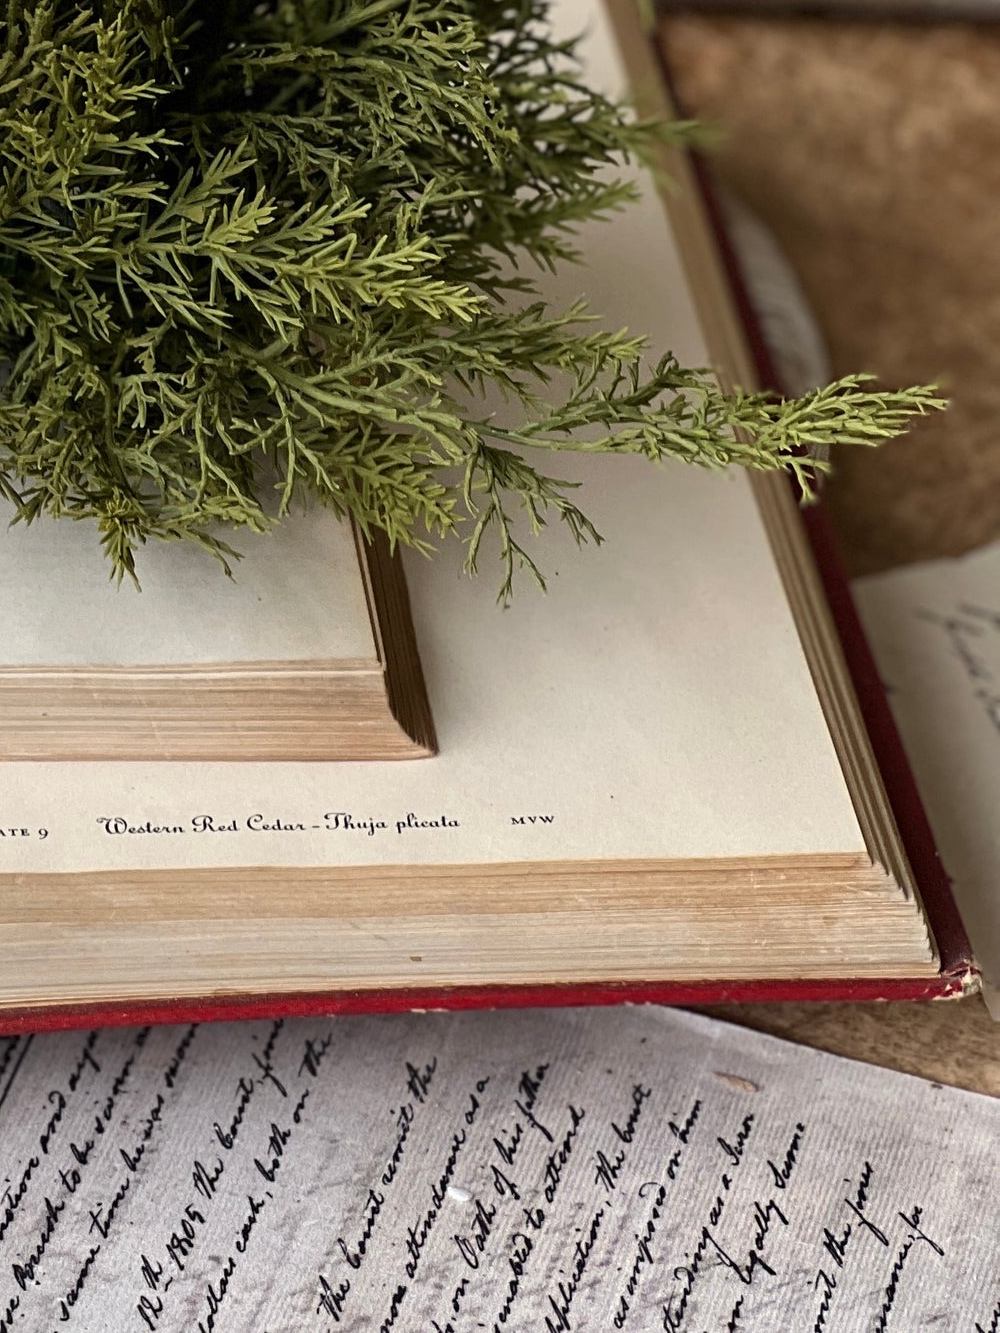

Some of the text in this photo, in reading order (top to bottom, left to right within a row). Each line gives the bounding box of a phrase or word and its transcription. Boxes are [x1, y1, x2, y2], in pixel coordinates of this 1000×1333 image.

[96, 812, 461, 836] Western Red Cedar Thuja plicata
[510, 815, 555, 826] MVW
[38, 828, 50, 840] 9
